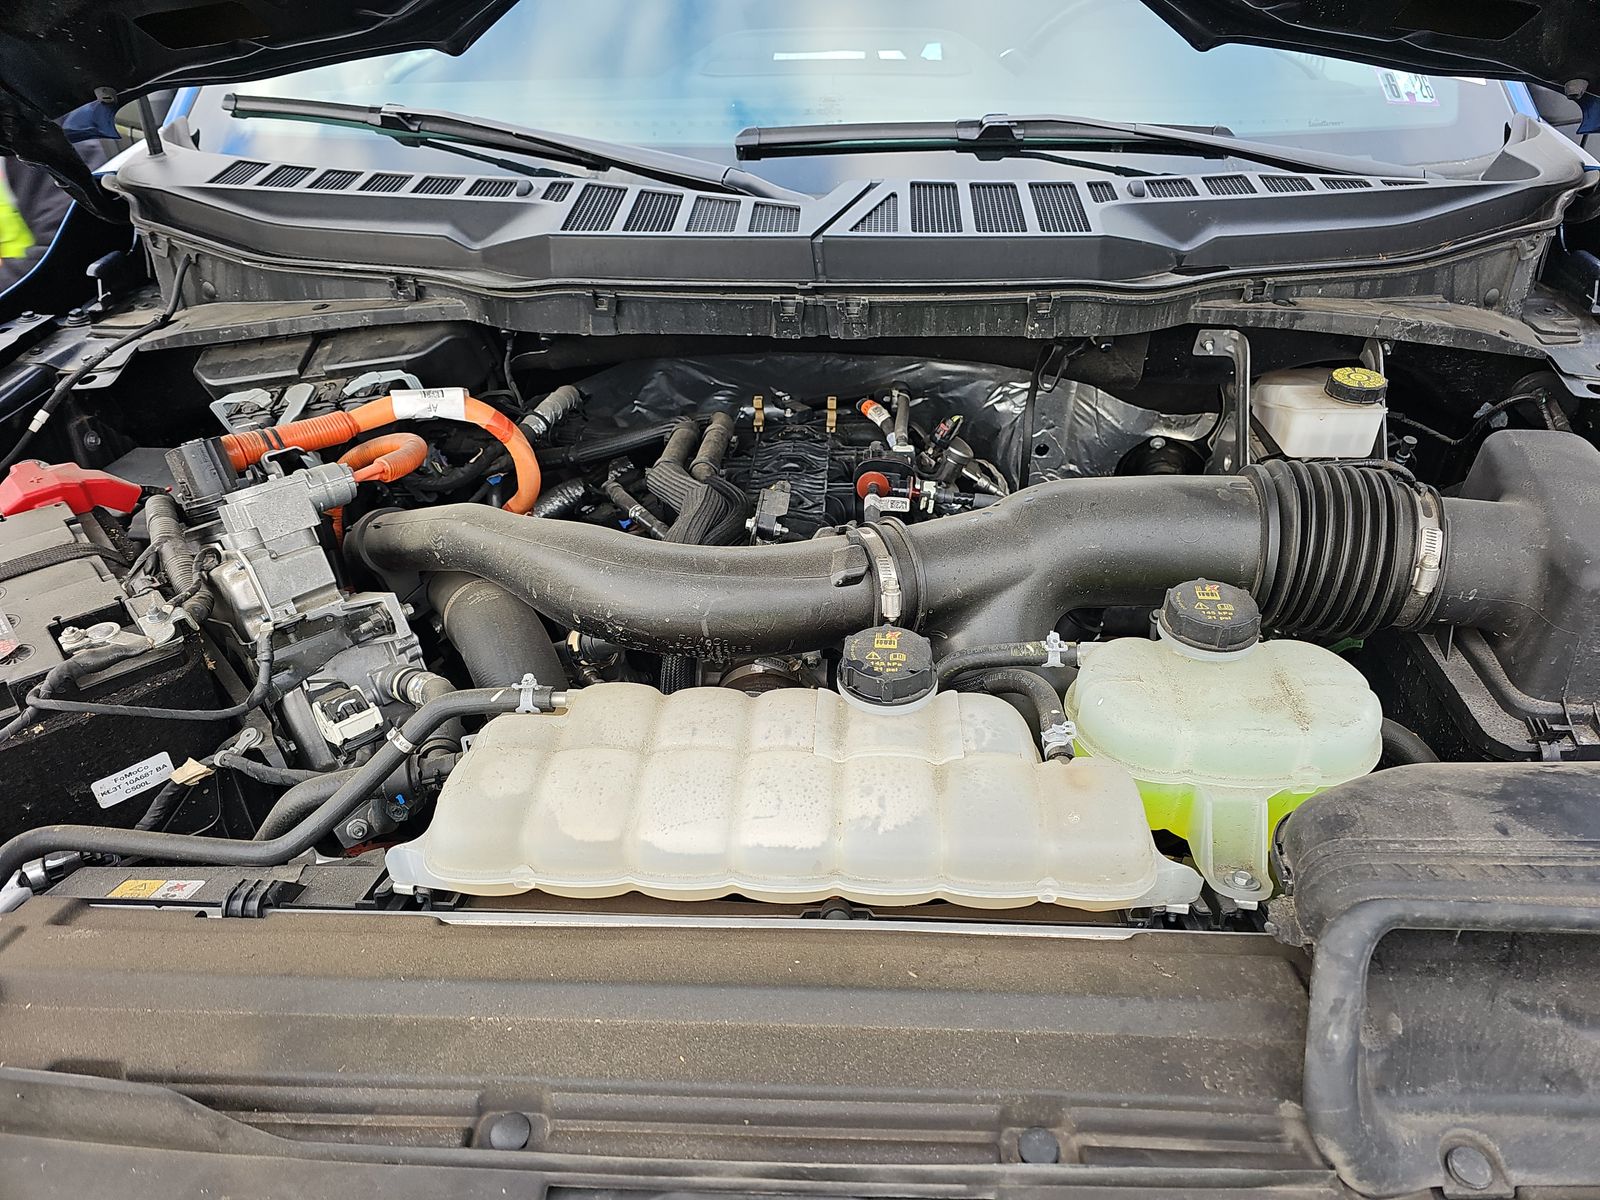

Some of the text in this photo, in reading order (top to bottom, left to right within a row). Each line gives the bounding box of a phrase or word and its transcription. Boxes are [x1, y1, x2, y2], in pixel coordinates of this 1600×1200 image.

[1384, 72, 1401, 99] 6
[1414, 74, 1434, 99] 26
[113, 765, 149, 783] FoMoCo
[125, 780, 151, 794] C500L
